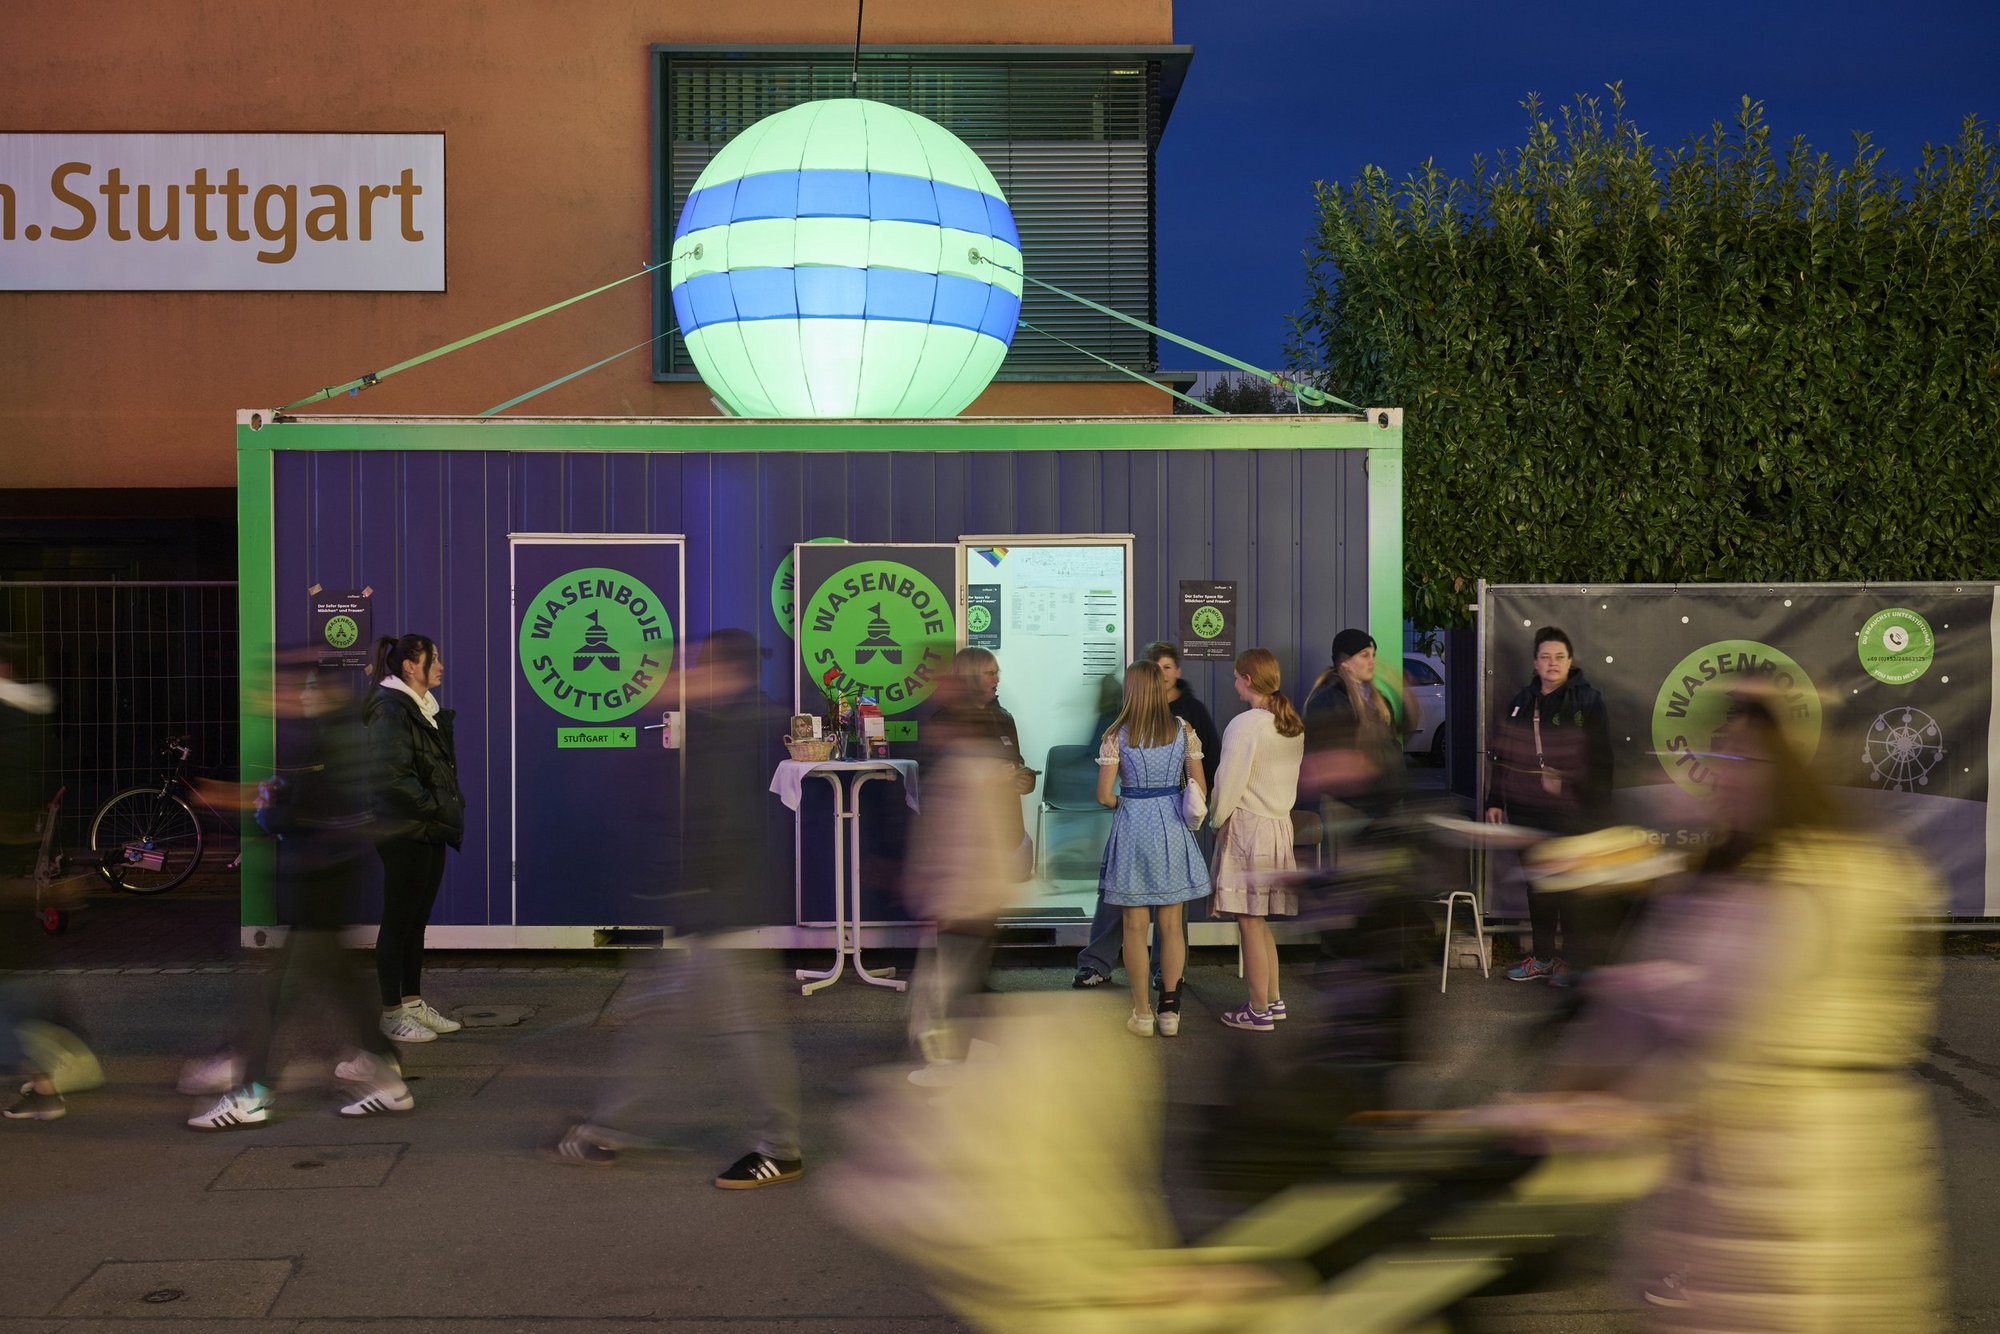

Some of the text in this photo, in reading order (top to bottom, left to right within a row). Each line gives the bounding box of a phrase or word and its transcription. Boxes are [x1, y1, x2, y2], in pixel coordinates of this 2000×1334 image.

[531, 579, 661, 641] WASENBOJE
[812, 572, 944, 635] WASENBOJE
[1865, 612, 1891, 634] BRAUCHST
[533, 654, 660, 710] STUTTGART
[1874, 669, 1885, 679] YOU
[1903, 668, 1919, 680] HELP?
[563, 734, 608, 742] STUTTGART
